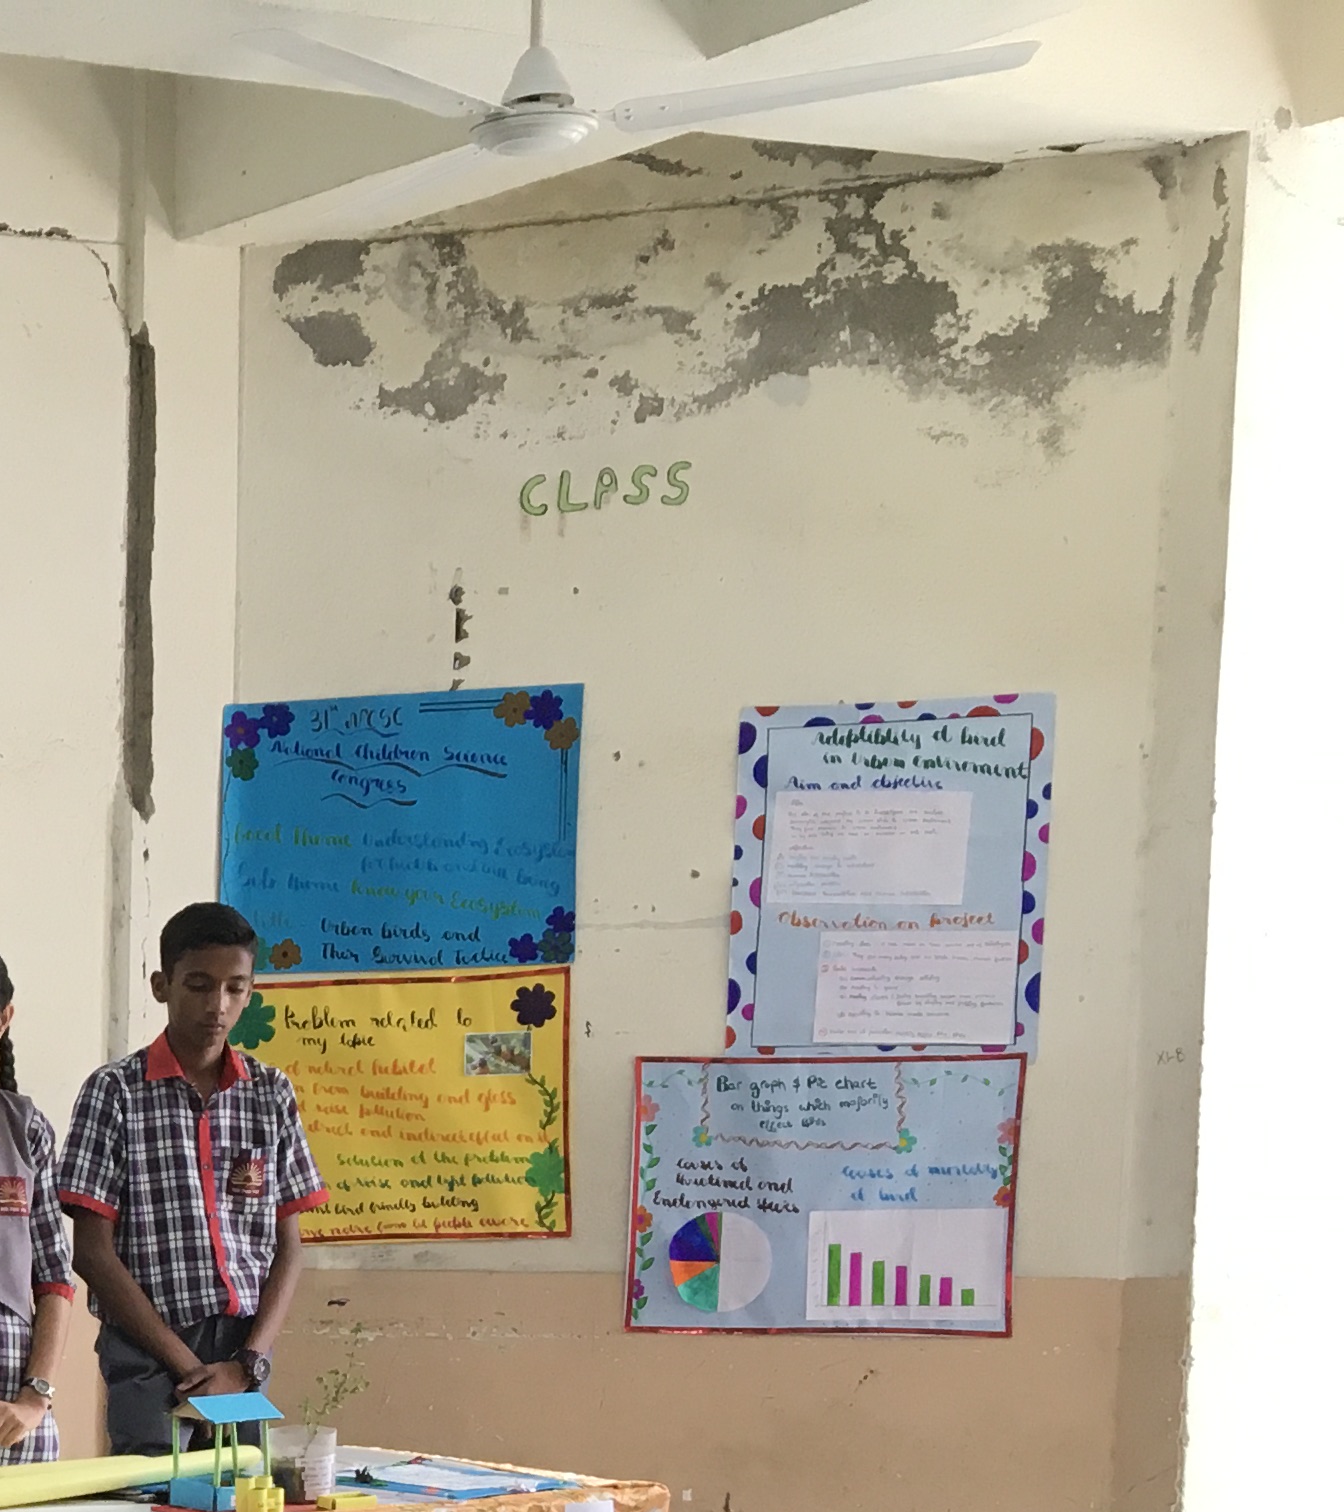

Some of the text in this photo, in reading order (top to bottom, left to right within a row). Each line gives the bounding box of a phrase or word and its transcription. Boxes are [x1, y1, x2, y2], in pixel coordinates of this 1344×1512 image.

[520, 461, 692, 516] CLASS
[716, 1074, 743, 1093] Bar
[834, 1075, 878, 1091] chart
